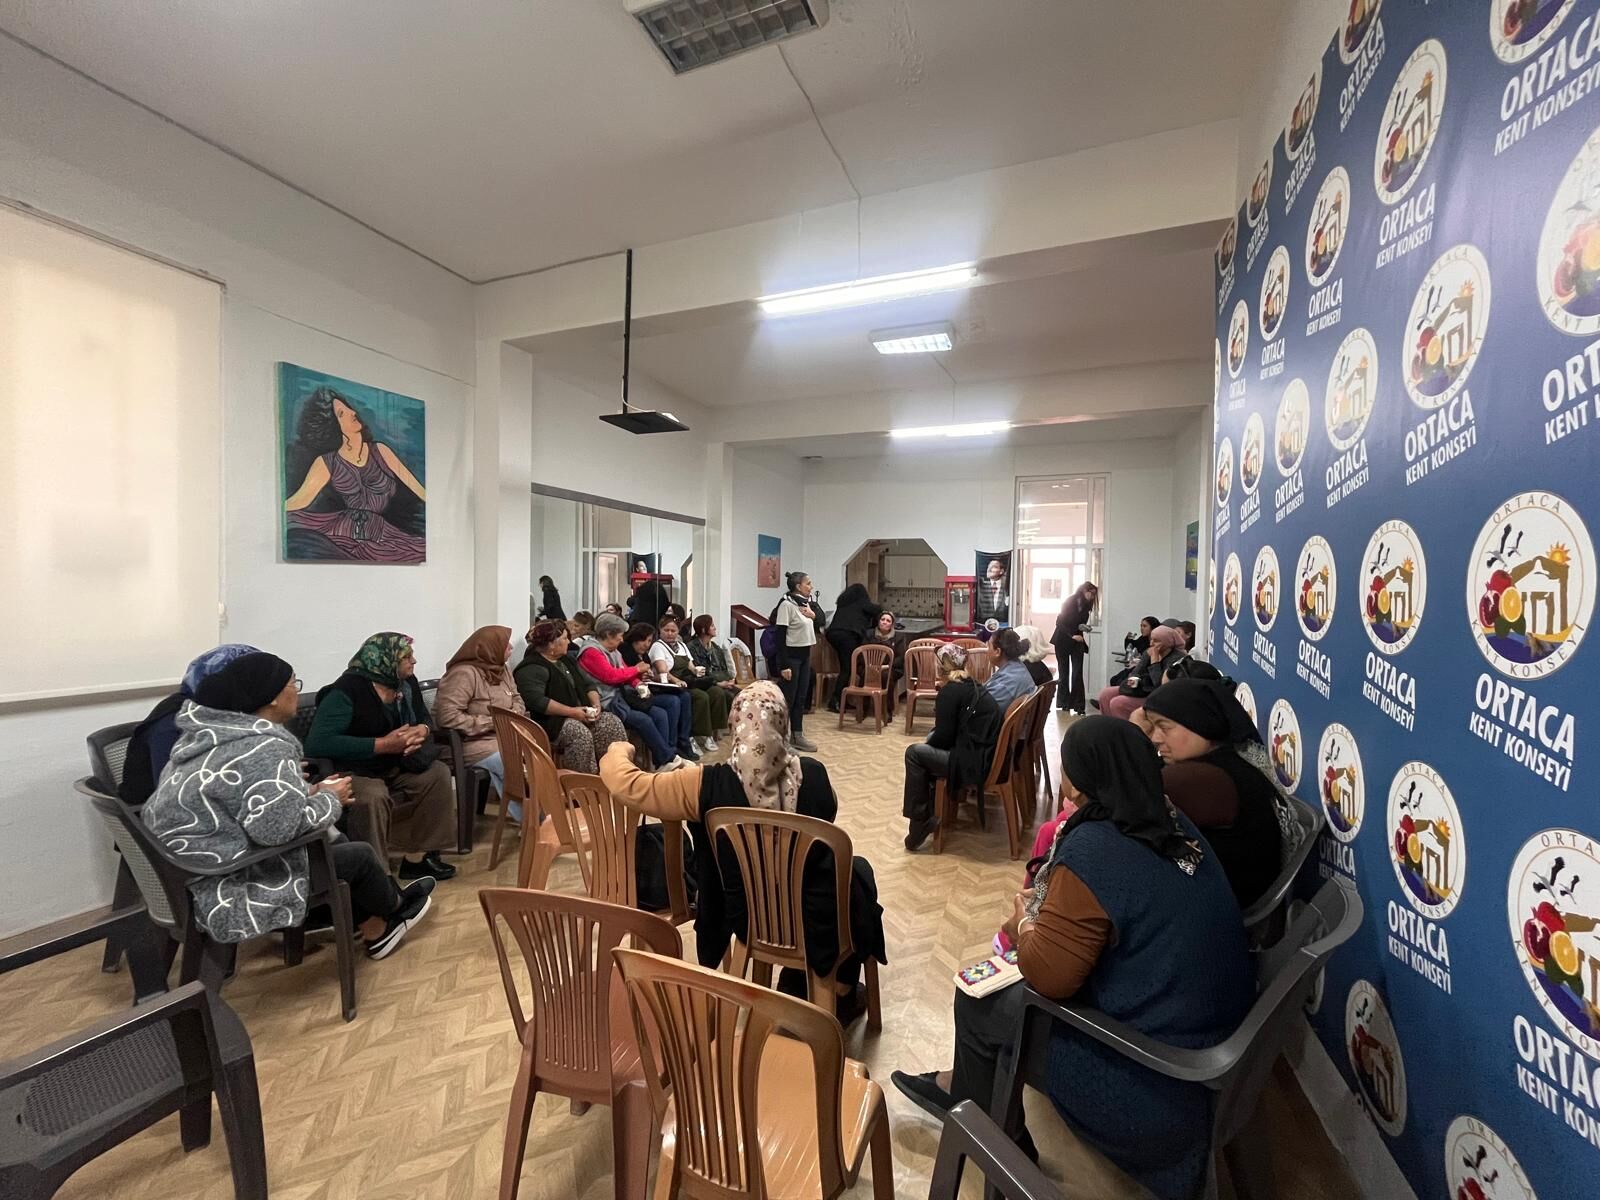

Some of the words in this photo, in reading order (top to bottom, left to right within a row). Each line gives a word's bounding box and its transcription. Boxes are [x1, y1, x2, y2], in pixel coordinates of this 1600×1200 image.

[1339, 17, 1384, 114] ORTACA
[1494, 111, 1531, 157] KENT
[1285, 130, 1316, 200] ORTACA
[1379, 183, 1436, 246] ORTACA
[1376, 242, 1396, 270] KENT
[1308, 278, 1343, 318] ORTACA
[1404, 389, 1475, 463] ORTACA
[1545, 400, 1588, 445] KENT
[1326, 438, 1369, 490] ORTACA
[1405, 456, 1429, 487] KENT
[1431, 420, 1477, 470] KONSEYİ
[1275, 468, 1304, 509] ORTACA
[1326, 487, 1341, 509] KENT
[1493, 494, 1560, 525] ORTACA
[1254, 631, 1276, 666] ORTACA
[1299, 639, 1331, 682] ORTACA
[1472, 620, 1499, 665] KENT
[1365, 651, 1416, 710] ORTACA
[1363, 681, 1380, 710] KENT
[1381, 694, 1415, 733] KONSEYİ
[1476, 673, 1575, 761] ORTACA
[1469, 711, 1503, 748] KENT
[1504, 732, 1572, 792] KONSEYİ
[1403, 763, 1446, 793] ORTACA
[1319, 836, 1356, 877] ORTACA
[1388, 900, 1450, 967] ORTACA
[1388, 935, 1409, 964] KENT
[1411, 949, 1452, 995] KONSEYİ
[1514, 939, 1551, 1008] KENT
[1516, 1062, 1559, 1115] KENT
